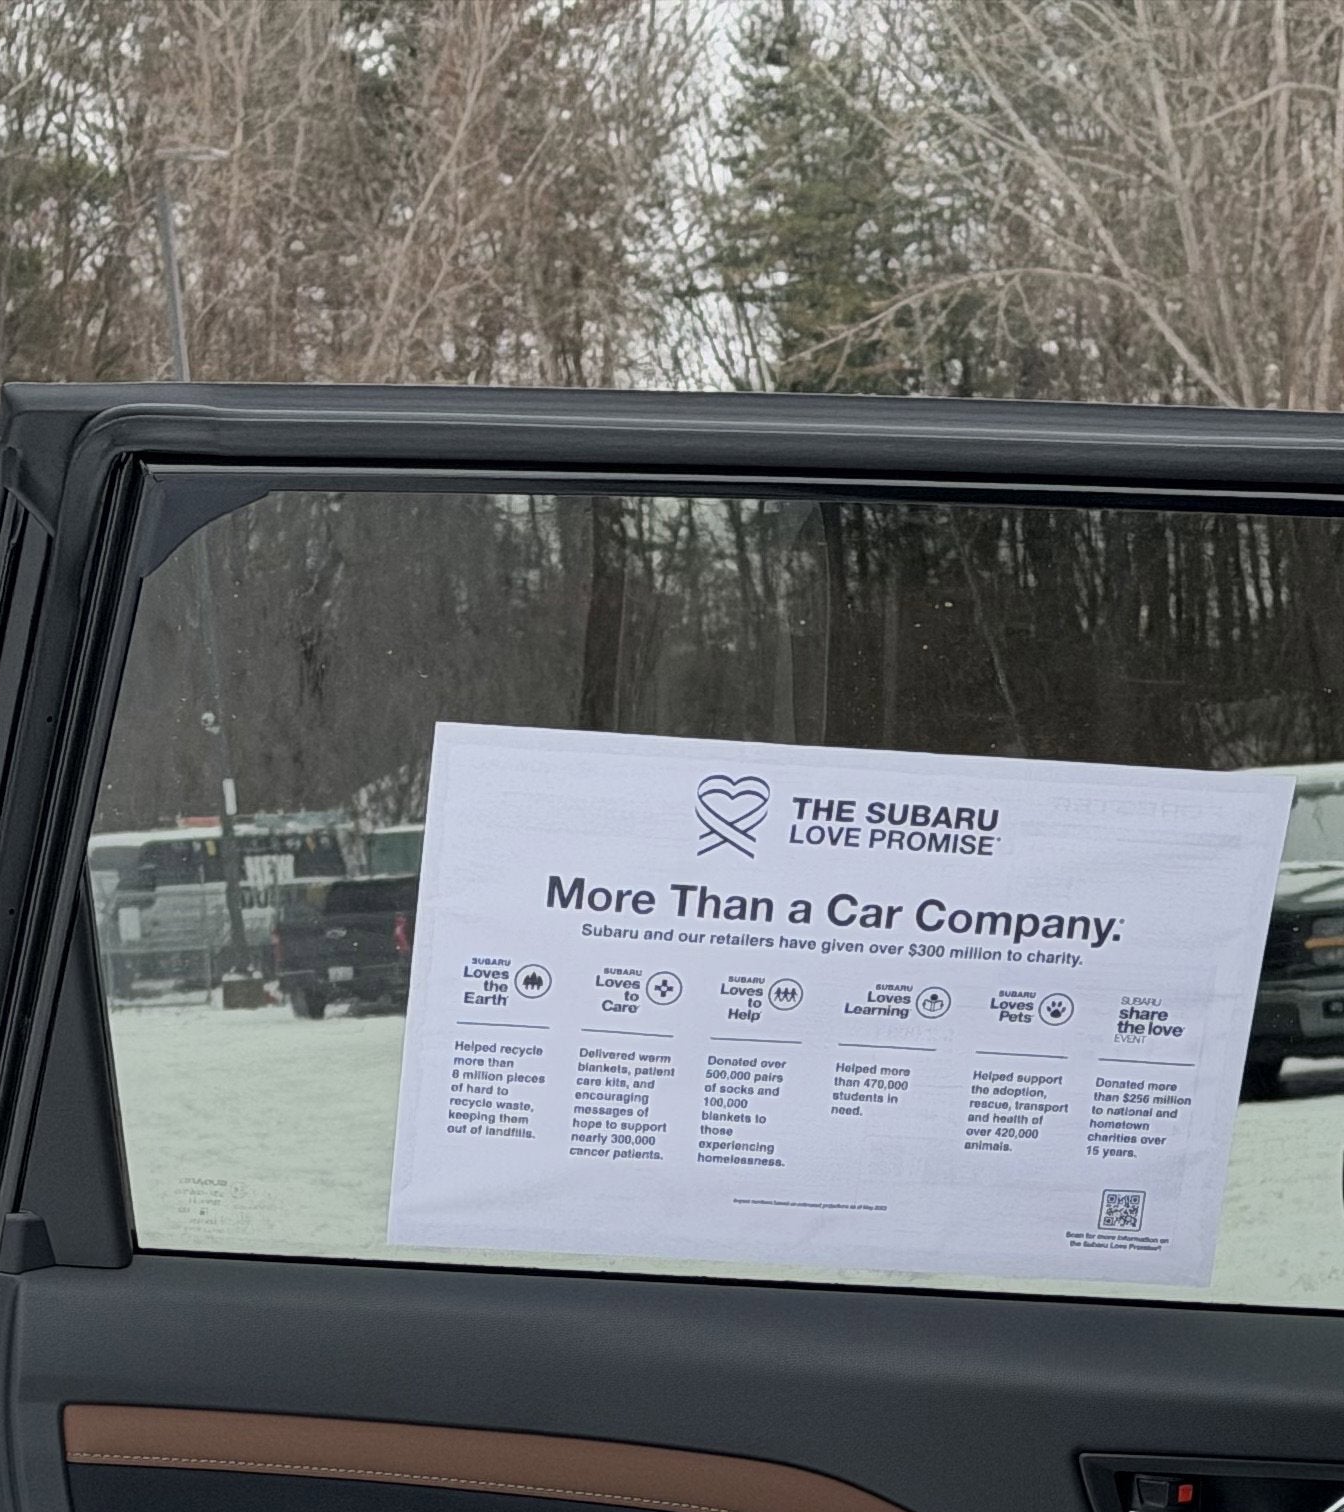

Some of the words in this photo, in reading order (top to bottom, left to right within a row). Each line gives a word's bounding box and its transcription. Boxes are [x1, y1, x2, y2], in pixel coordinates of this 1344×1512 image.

[792, 797, 856, 822] THE
[865, 802, 999, 831] SUBARU
[789, 824, 861, 847] LOVE
[869, 829, 993, 856] PROMISE
[547, 875, 655, 915] More
[670, 884, 774, 922] Than
[788, 900, 812, 924] a
[827, 893, 903, 929] Car
[916, 899, 1122, 946] Company.
[581, 923, 639, 939] Subaru
[643, 929, 674, 941] and
[678, 932, 706, 943] our
[710, 933, 774, 947] retailers
[779, 935, 816, 950] have
[821, 938, 864, 954] given
[869, 944, 904, 955] over
[908, 943, 945, 958] $300
[949, 946, 1002, 961] million
[1007, 949, 1022, 962] to
[1027, 950, 1083, 967] charity.
[472, 957, 511, 967] SUBARU
[463, 965, 509, 981] Loves
[604, 967, 643, 977] SUBARU
[483, 980, 508, 992] the
[595, 975, 640, 989] Loves
[728, 976, 765, 984] SUBARU
[720, 983, 763, 997] Loves
[875, 984, 913, 992] SUBARU
[998, 990, 1037, 999] SUBARU
[464, 991, 508, 1006] Earth
[624, 990, 639, 1002] to
[748, 998, 762, 1008] to
[867, 991, 911, 1004] Loves
[1120, 996, 1162, 1007] SUBARU
[601, 999, 639, 1014] Care
[844, 1002, 909, 1019] Learning
[990, 997, 1034, 1012] Loves
[728, 1008, 761, 1023] Help
[999, 1009, 1032, 1023] Pets
[1119, 1006, 1168, 1022] share
[1117, 1020, 1145, 1035] the
[1148, 1022, 1183, 1037] love
[1113, 1033, 1147, 1044] EVENT
[454, 1040, 497, 1054] Helped
[500, 1045, 543, 1058] recycle
[579, 1048, 636, 1061] Delivered
[638, 1054, 671, 1063] warm
[454, 1057, 485, 1067] more
[488, 1057, 514, 1068] than
[578, 1061, 631, 1076] blankets,
[634, 1067, 675, 1077] patient
[707, 1055, 757, 1067] Donated
[760, 1060, 787, 1069] over
[452, 1069, 460, 1079] 8
[462, 1070, 503, 1081] million
[506, 1072, 545, 1084] pieces
[705, 1069, 751, 1081] 500,000
[753, 1072, 783, 1084] pairs
[836, 1062, 877, 1076] Helped
[880, 1067, 911, 1077] more
[576, 1077, 602, 1087] care
[605, 1077, 629, 1089] kits,
[633, 1080, 655, 1089] and
[834, 1076, 860, 1088] than
[863, 1078, 908, 1091] 470,000
[973, 1070, 1014, 1083] Helped
[1016, 1074, 1063, 1086] support
[1095, 1077, 1145, 1090] Donated
[1147, 1083, 1178, 1092] more
[451, 1083, 464, 1092] of
[466, 1083, 493, 1095] hard
[497, 1086, 509, 1096] to
[704, 1083, 717, 1092] of
[719, 1084, 754, 1095] socks
[757, 1087, 780, 1096] and
[971, 1085, 990, 1095] the
[992, 1086, 1047, 1100] adoption,
[575, 1091, 649, 1105] encouraging
[704, 1096, 748, 1109] 100,000
[832, 1091, 884, 1103] students
[887, 1093, 898, 1104] in
[1094, 1092, 1120, 1102] than
[1122, 1093, 1150, 1104] $256
[1152, 1095, 1192, 1106] million
[449, 1098, 493, 1109] recycle
[496, 1101, 534, 1113] waste,
[574, 1106, 634, 1118] messages
[636, 1107, 649, 1117] of
[831, 1106, 863, 1116] need.
[969, 1100, 1011, 1111] rescue,
[1015, 1101, 1068, 1114] transport
[1092, 1105, 1104, 1115] to
[1106, 1107, 1153, 1117] national
[1155, 1109, 1178, 1119] and
[448, 1109, 496, 1124] keeping
[499, 1113, 529, 1124] them
[701, 1110, 751, 1123] blankets
[755, 1114, 767, 1124] to
[967, 1113, 990, 1123] and
[992, 1113, 1029, 1125] health
[1031, 1115, 1044, 1125] of
[447, 1124, 467, 1134] out
[470, 1124, 482, 1135] of
[485, 1125, 535, 1139] landfills.
[572, 1117, 602, 1130] hope
[605, 1120, 617, 1129] to
[620, 1122, 667, 1134] support
[700, 1125, 733, 1136] those
[1089, 1119, 1150, 1131] hometown
[571, 1133, 608, 1145] nearly
[611, 1132, 656, 1146] 300,000
[966, 1128, 992, 1136] over
[994, 1127, 1039, 1139] 420,000
[1087, 1132, 1137, 1144] charities
[1140, 1136, 1167, 1145] over
[698, 1140, 775, 1155] experiencing
[964, 1140, 1012, 1152] animals.
[1086, 1145, 1099, 1156] 15
[1102, 1148, 1137, 1159] years.
[569, 1147, 610, 1157] cancer
[612, 1148, 663, 1160] patients.
[697, 1152, 785, 1167] homelessness.
